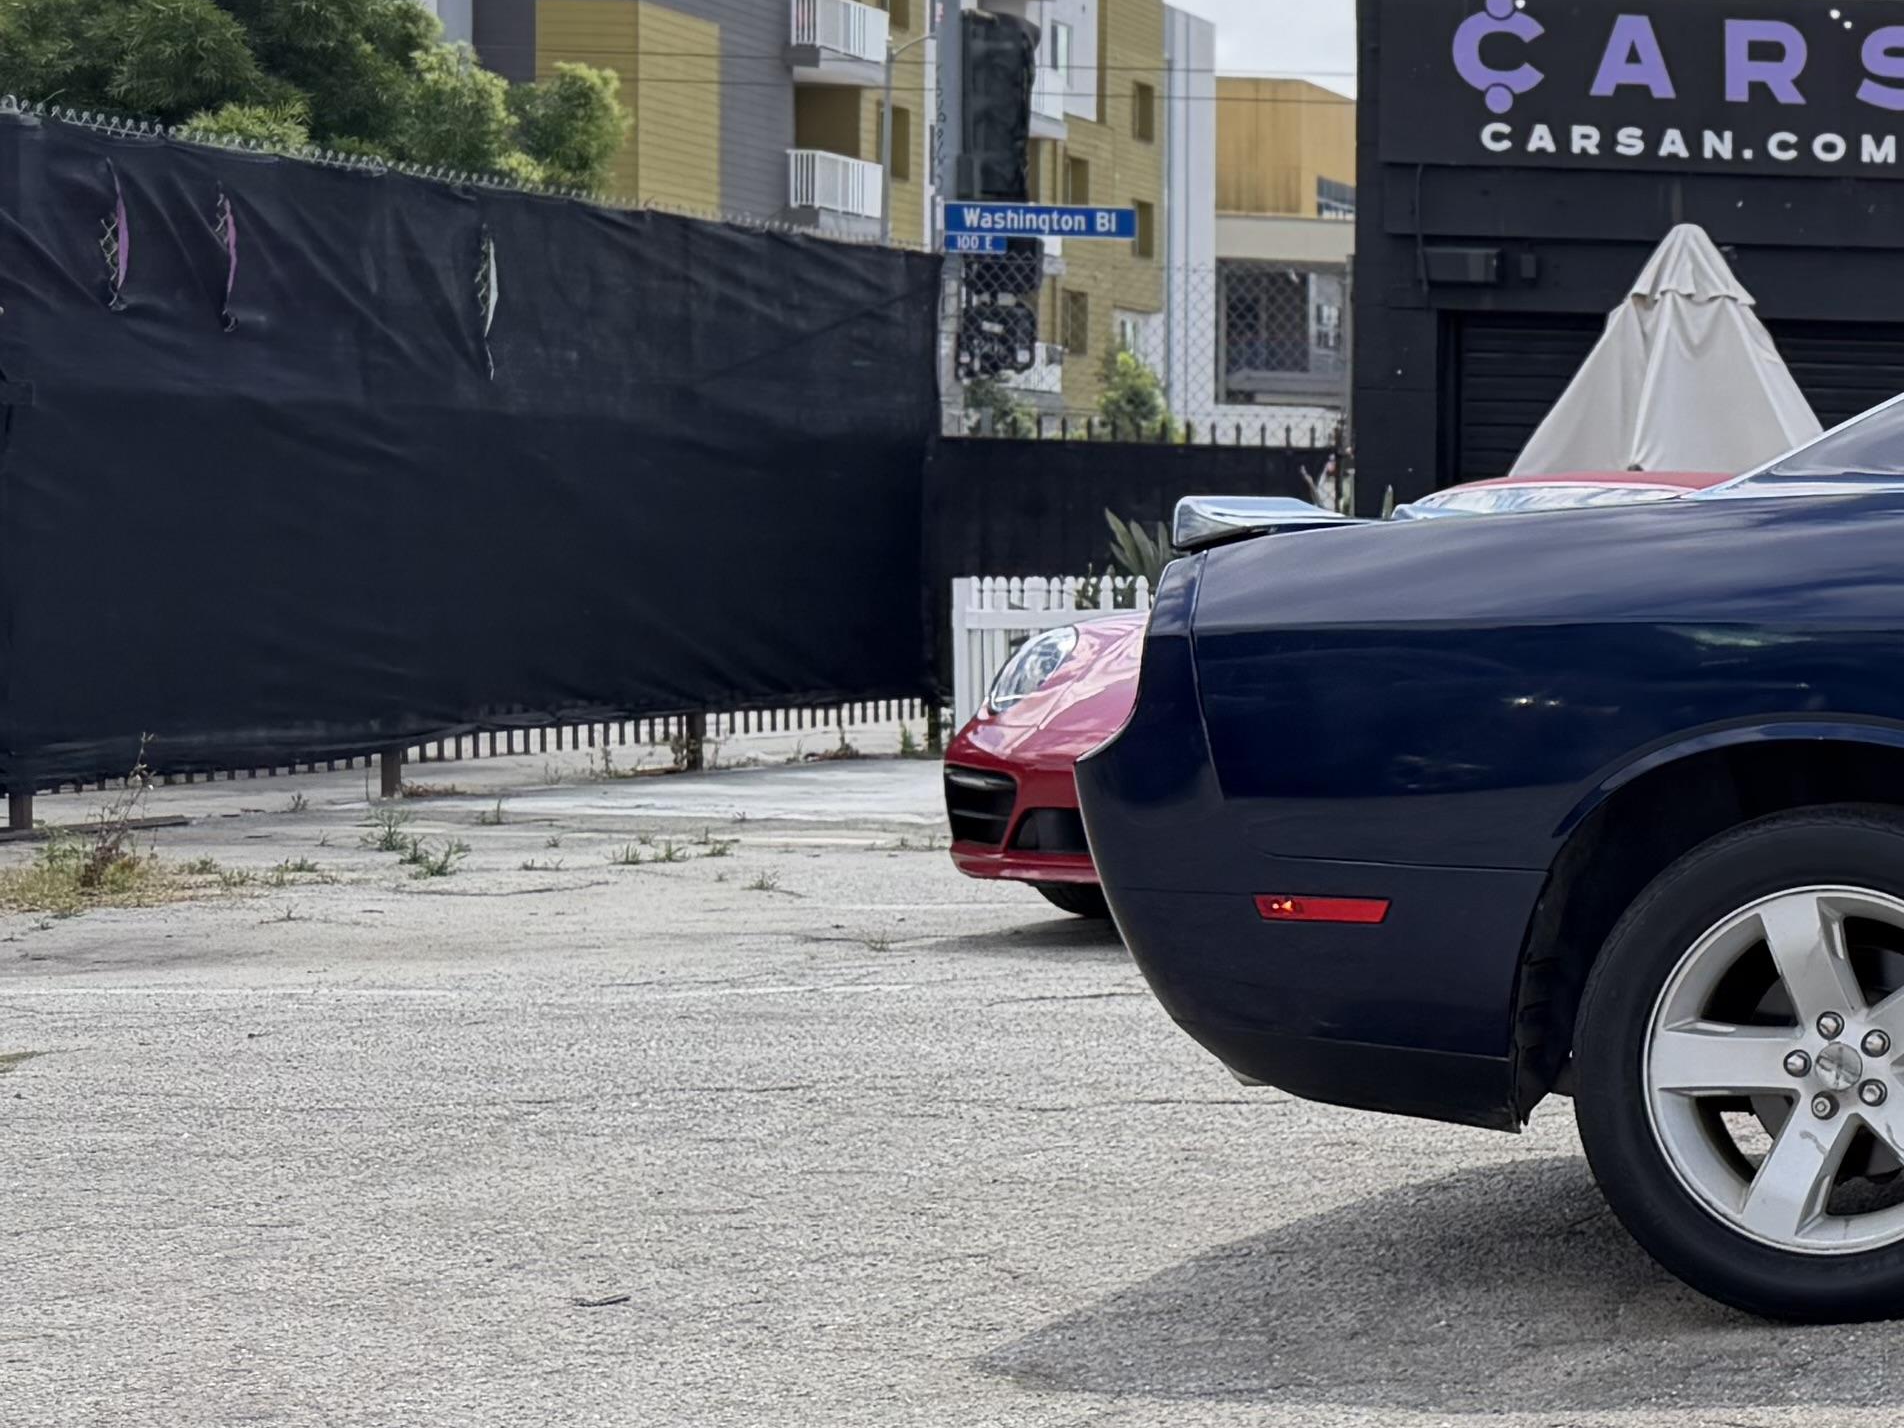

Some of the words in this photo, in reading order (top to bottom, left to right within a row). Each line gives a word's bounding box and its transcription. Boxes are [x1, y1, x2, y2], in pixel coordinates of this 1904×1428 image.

[1480, 122, 1896, 164] CARSAN.COM
[963, 206, 1086, 234] Washington
[1095, 212, 1116, 232] Bl
[956, 235, 979, 250] 100
[984, 236, 993, 250] E
